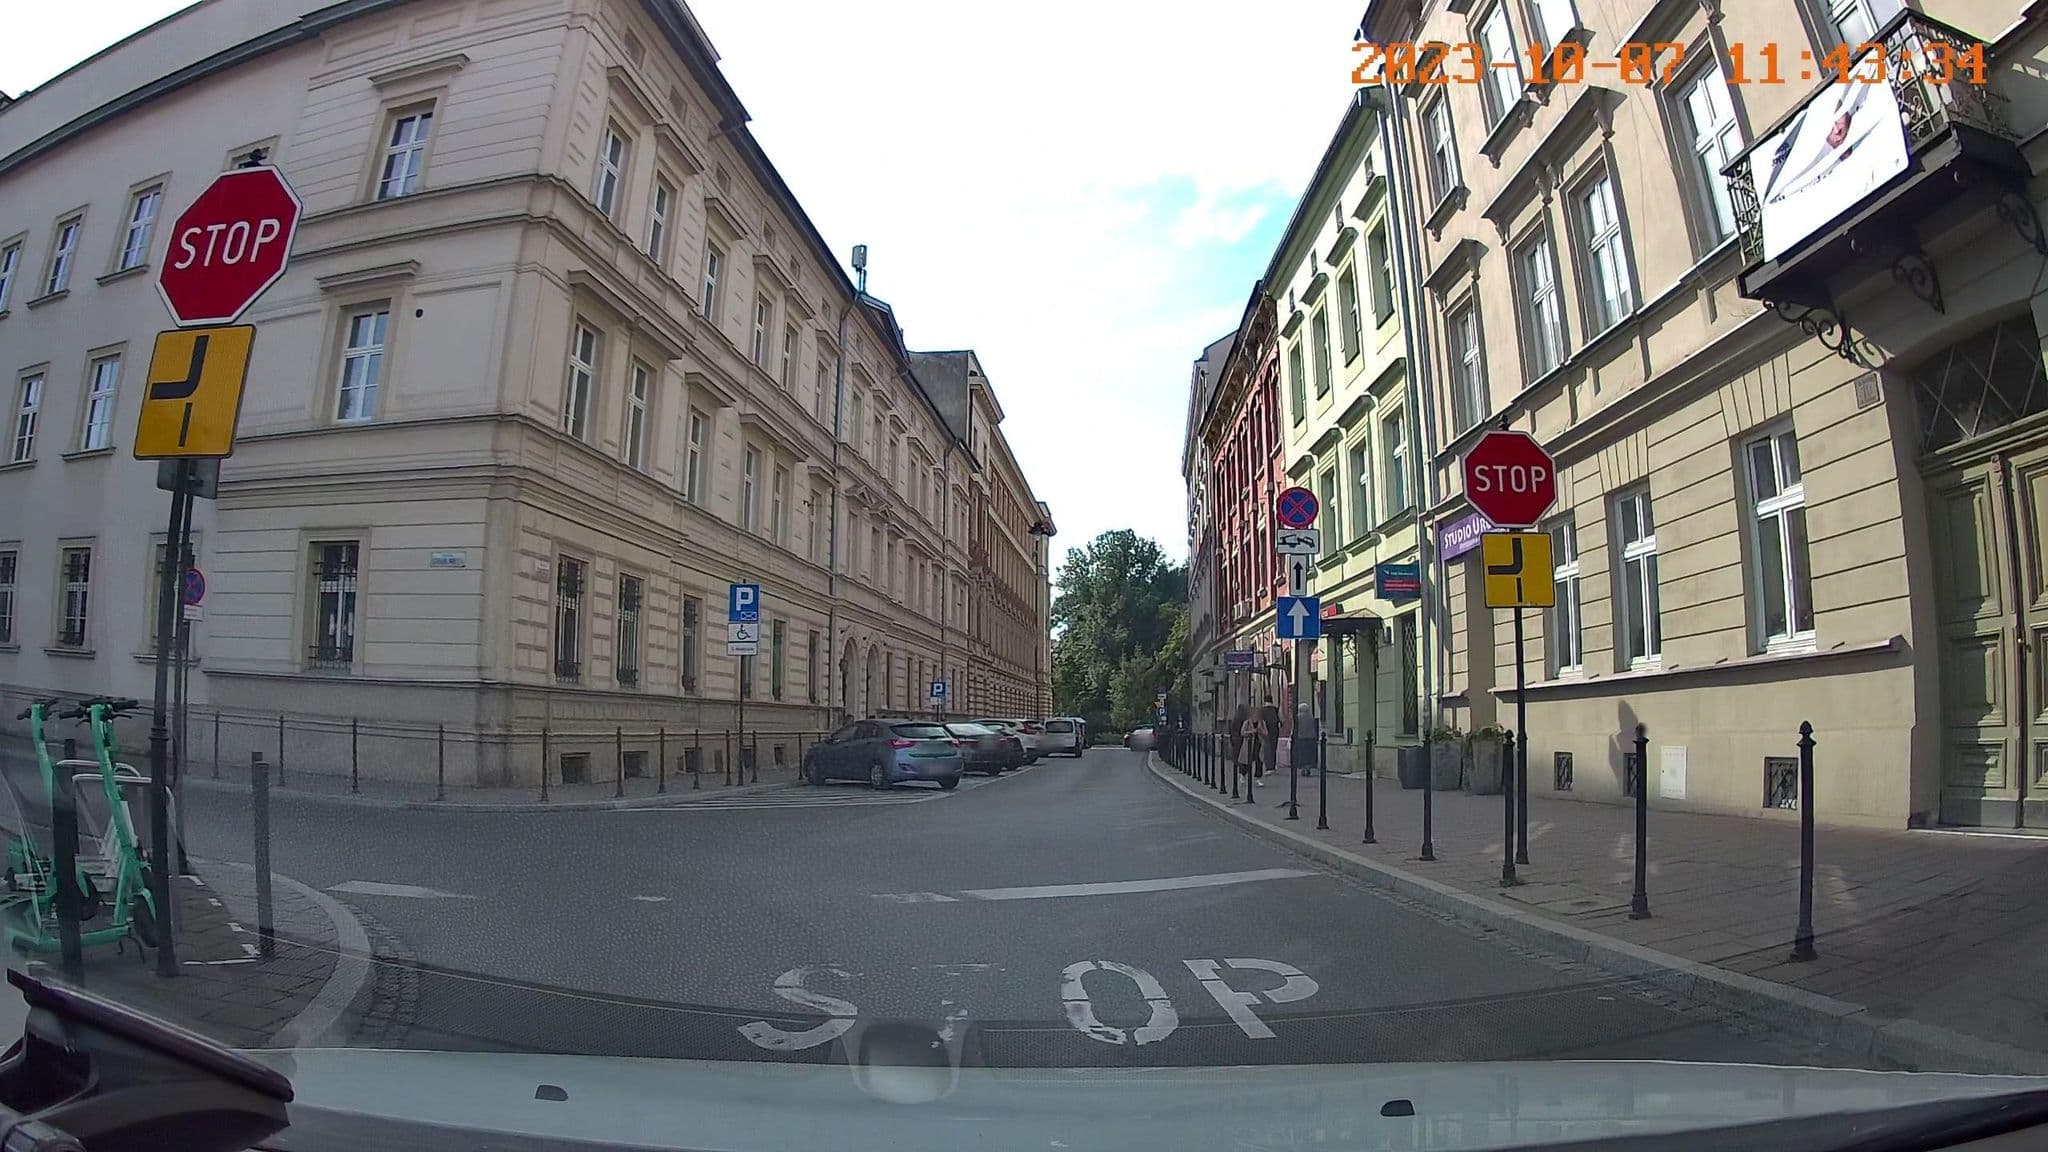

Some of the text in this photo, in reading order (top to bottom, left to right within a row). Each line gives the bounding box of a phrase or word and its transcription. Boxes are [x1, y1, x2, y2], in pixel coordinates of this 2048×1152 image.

[174, 218, 280, 269] STOP
[1474, 465, 1546, 493] STOP
[1444, 524, 1472, 549] STUDIO
[736, 587, 754, 611] P
[933, 683, 943, 696] P
